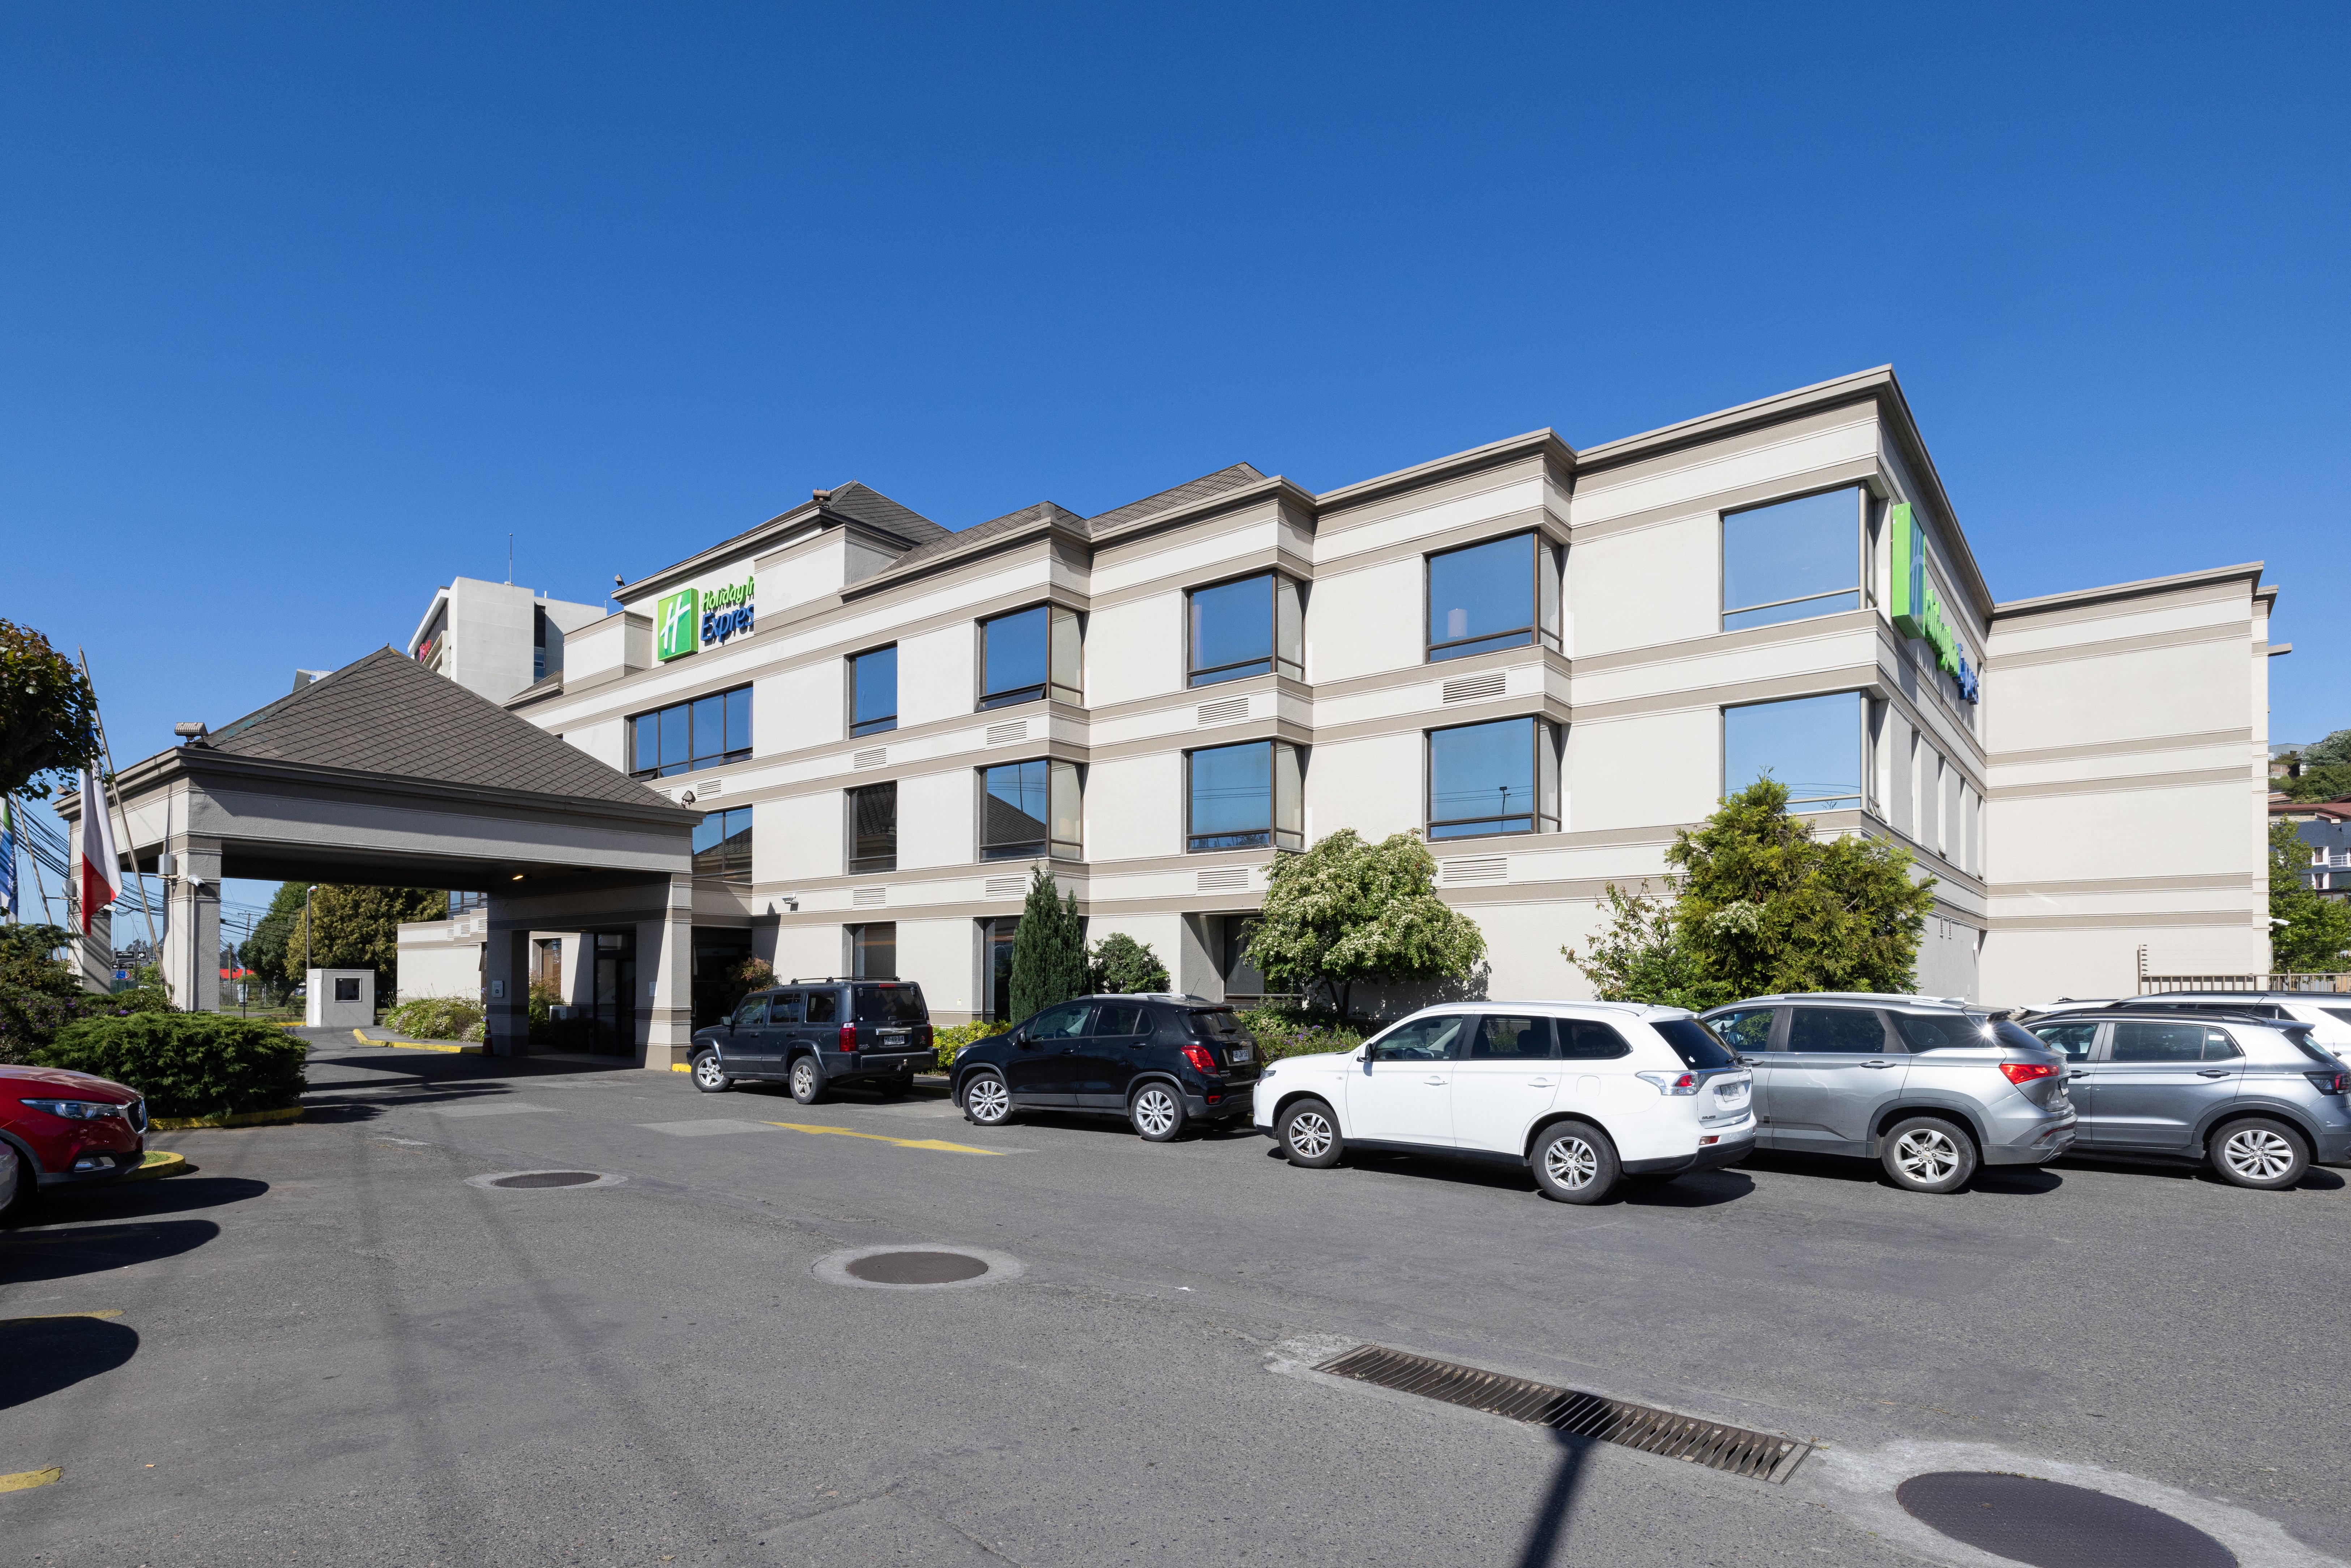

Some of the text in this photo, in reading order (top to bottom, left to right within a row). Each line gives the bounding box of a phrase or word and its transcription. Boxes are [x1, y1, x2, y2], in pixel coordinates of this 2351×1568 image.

[701, 576, 755, 612] Holiday In
[701, 604, 754, 642] Expres
